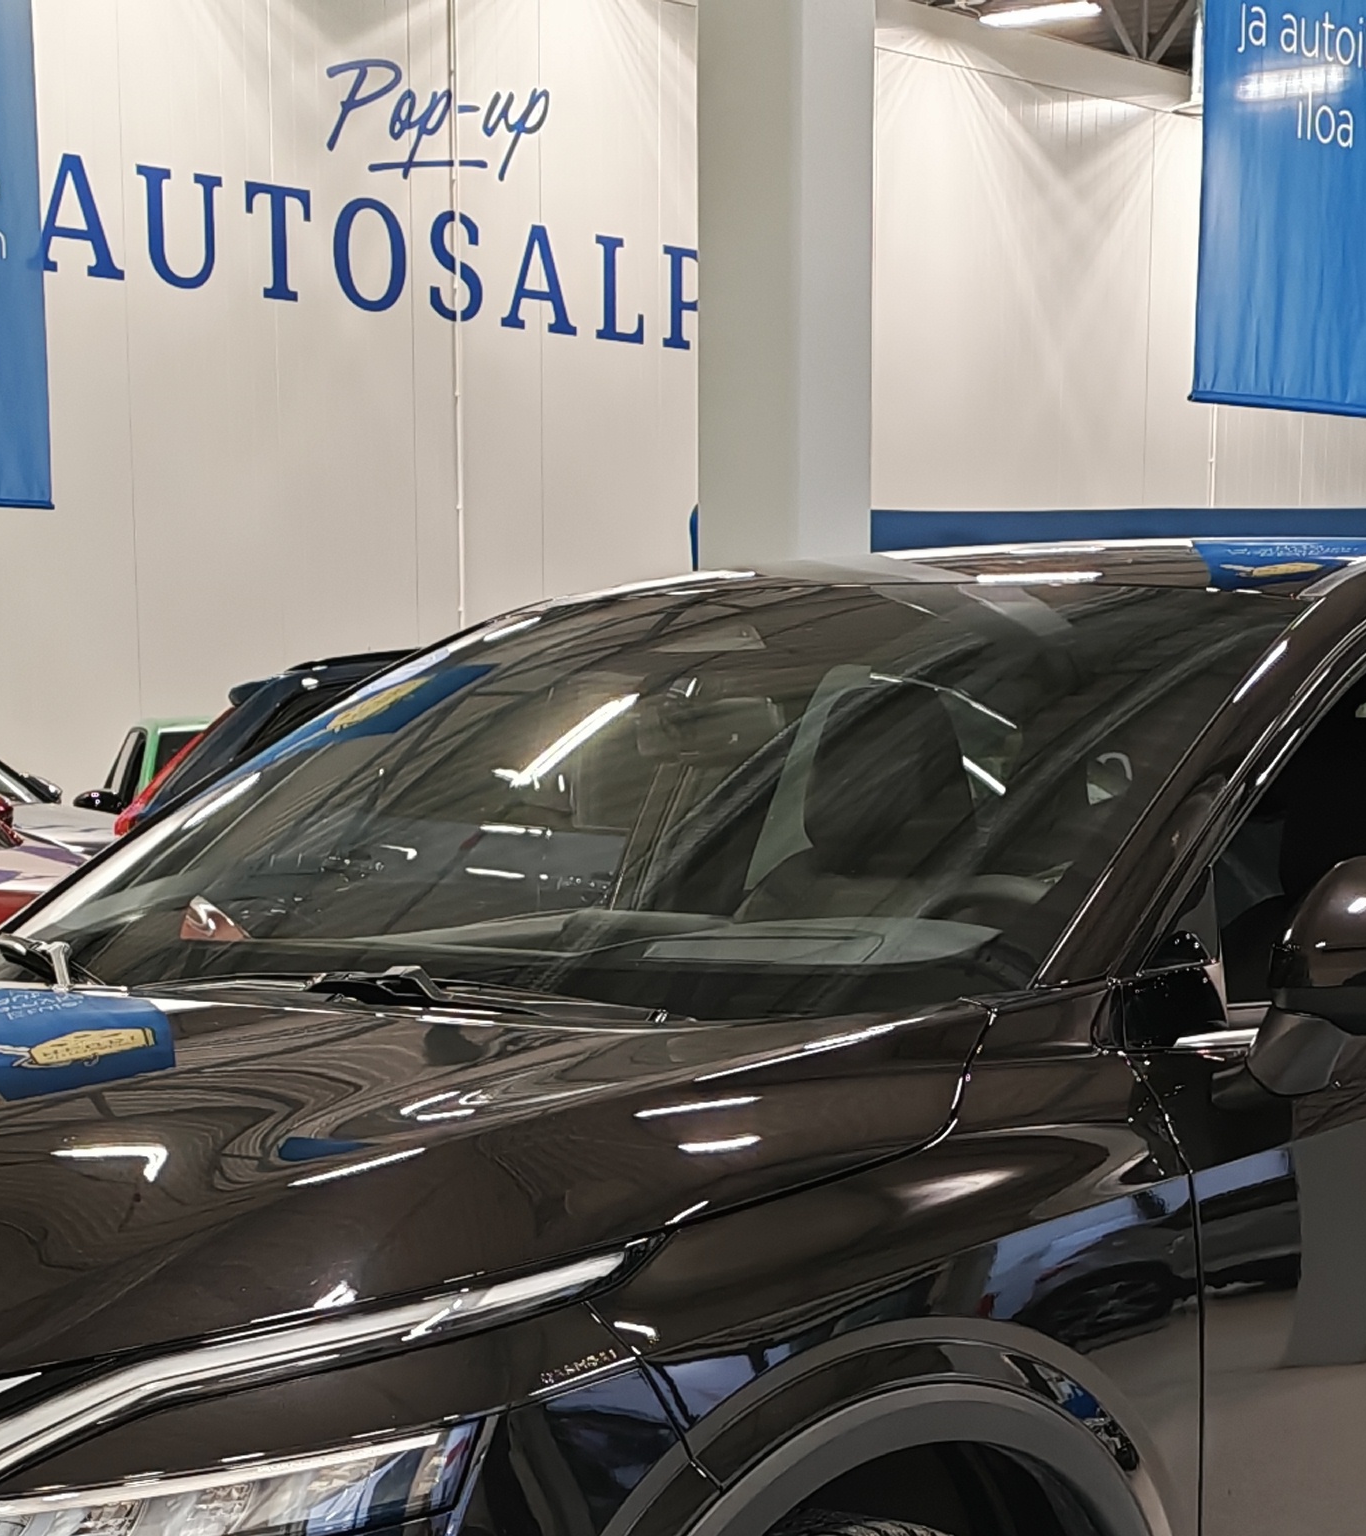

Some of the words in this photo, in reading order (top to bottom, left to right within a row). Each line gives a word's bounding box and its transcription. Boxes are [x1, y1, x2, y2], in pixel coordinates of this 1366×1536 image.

[1237, 3, 1266, 53] ja
[326, 58, 549, 181] Pop-up
[1297, 83, 1353, 148] iloa
